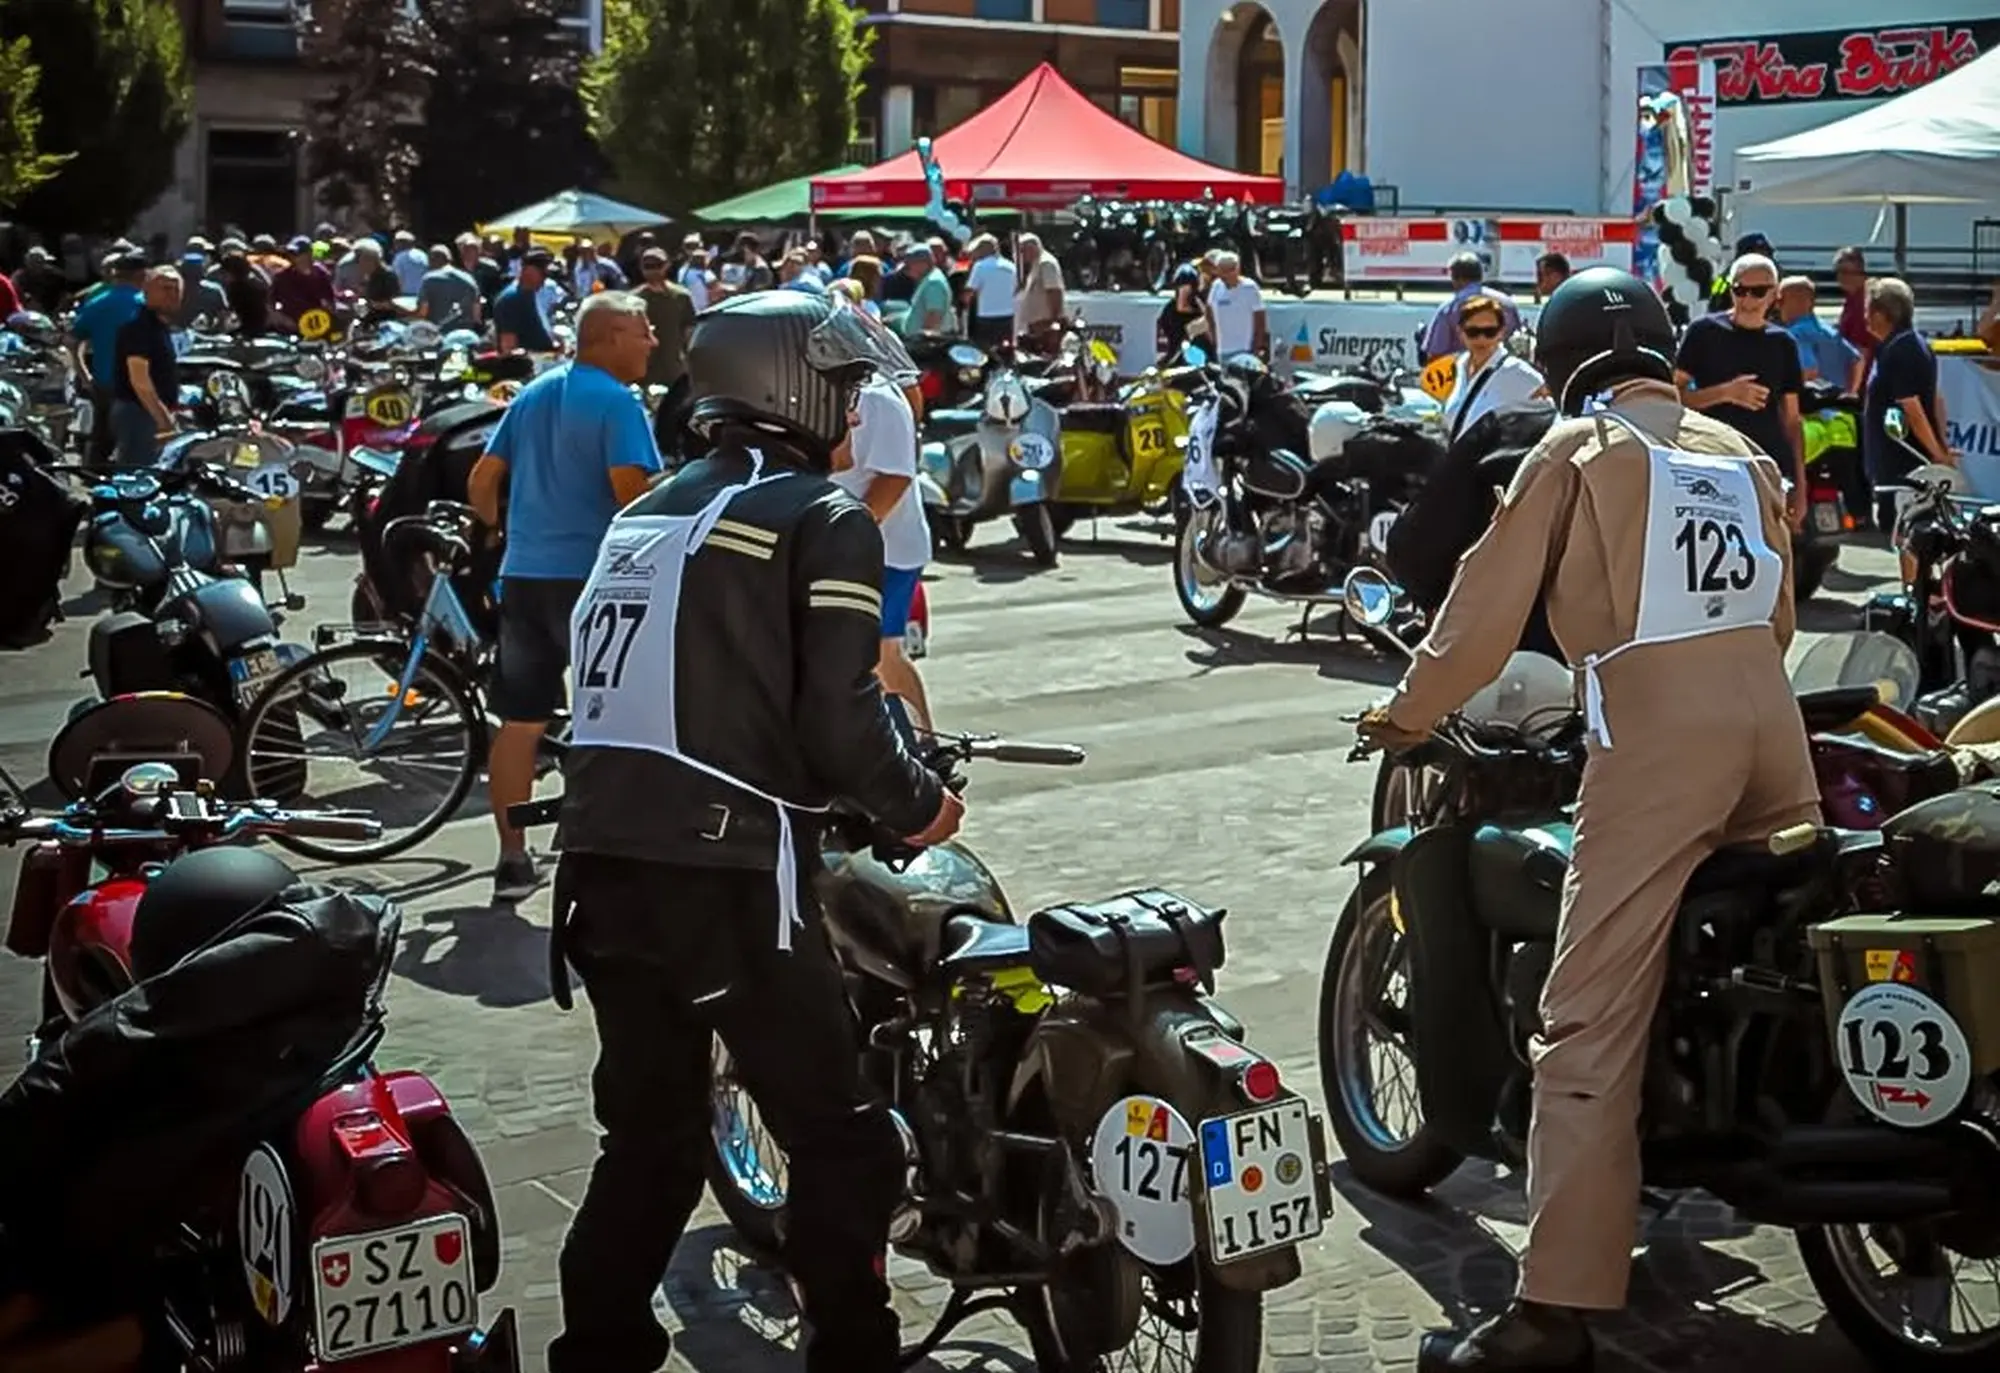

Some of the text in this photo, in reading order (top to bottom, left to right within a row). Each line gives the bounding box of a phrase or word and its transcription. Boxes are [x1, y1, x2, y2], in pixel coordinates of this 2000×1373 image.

[256, 472, 289, 496] 15
[1675, 518, 1756, 593] 123
[578, 602, 649, 689] 127
[1843, 1018, 1952, 1081] 123
[1234, 1111, 1282, 1157] FN
[1114, 1135, 1191, 1202] 127
[1212, 1162, 1224, 1178] D
[363, 1232, 423, 1286] SZ
[326, 1280, 467, 1351] 27110
